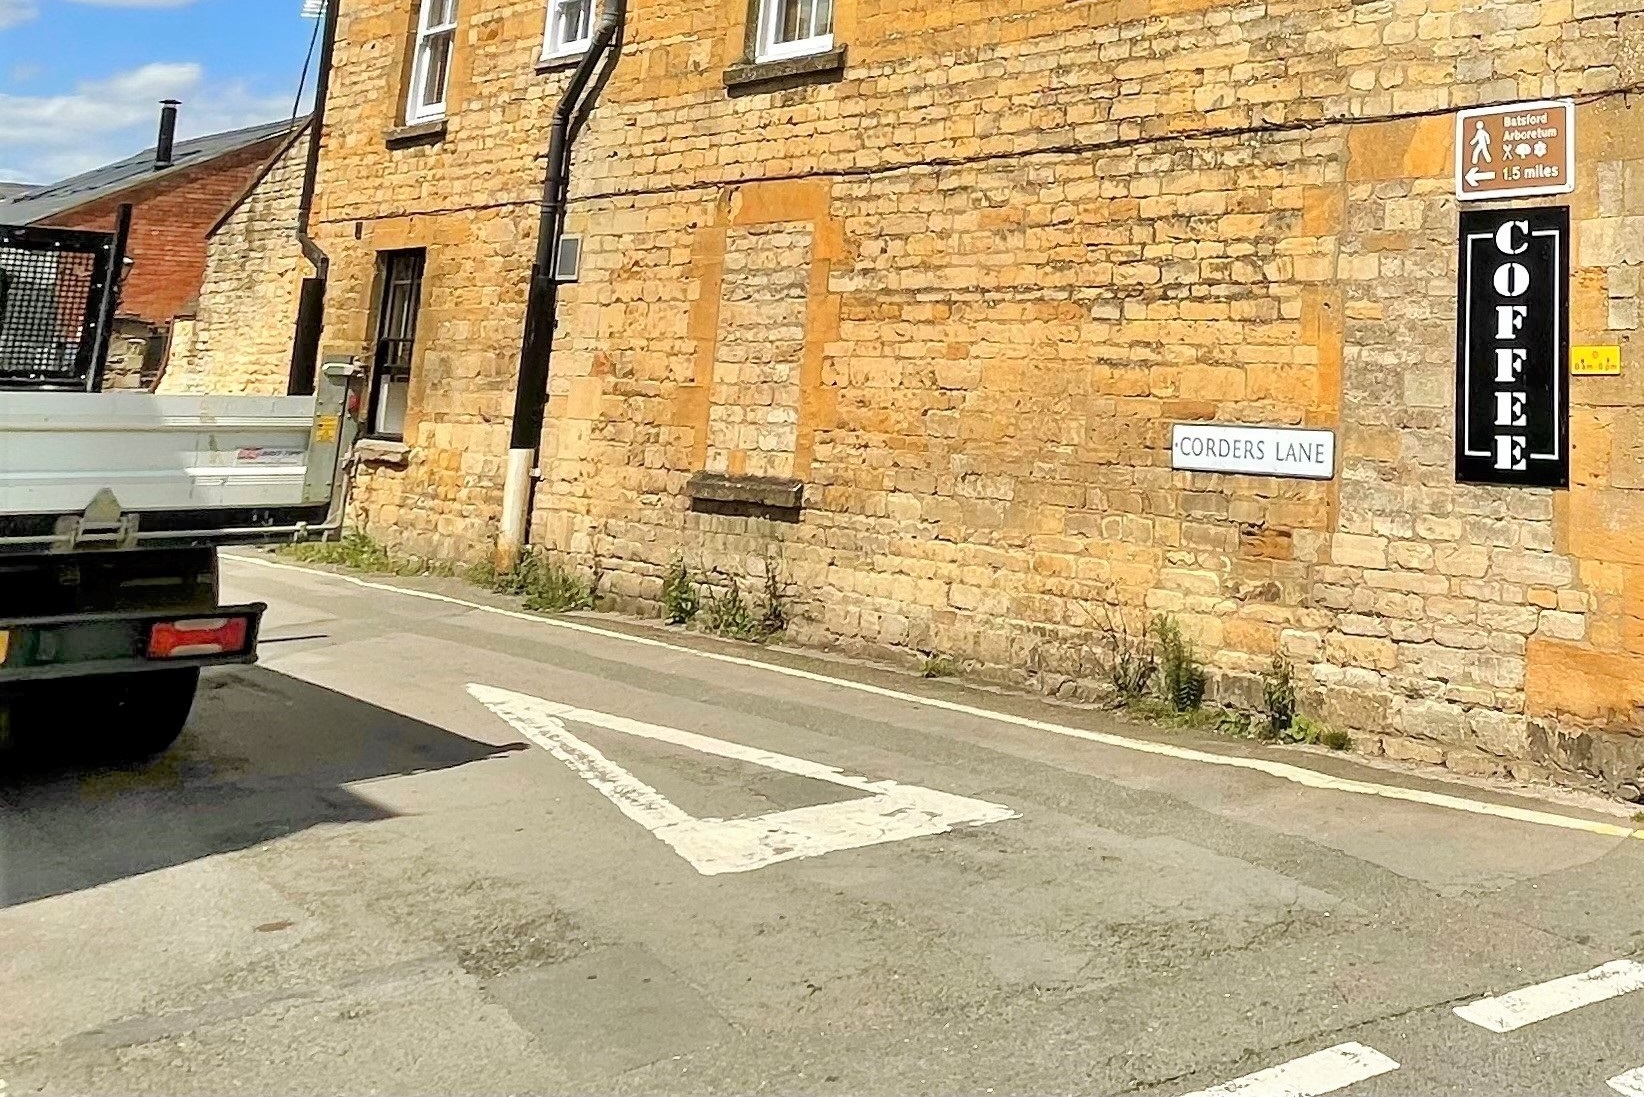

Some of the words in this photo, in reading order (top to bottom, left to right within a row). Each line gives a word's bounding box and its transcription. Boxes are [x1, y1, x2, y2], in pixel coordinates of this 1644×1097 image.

[1502, 112, 1549, 128] Batsford
[1502, 127, 1558, 142] Arboretum
[1502, 165, 1521, 181] 1.5
[1523, 163, 1560, 180] miles
[1493, 219, 1531, 471] COFFEE
[1180, 436, 1265, 461] CORDERS
[1275, 441, 1325, 464] LANE
